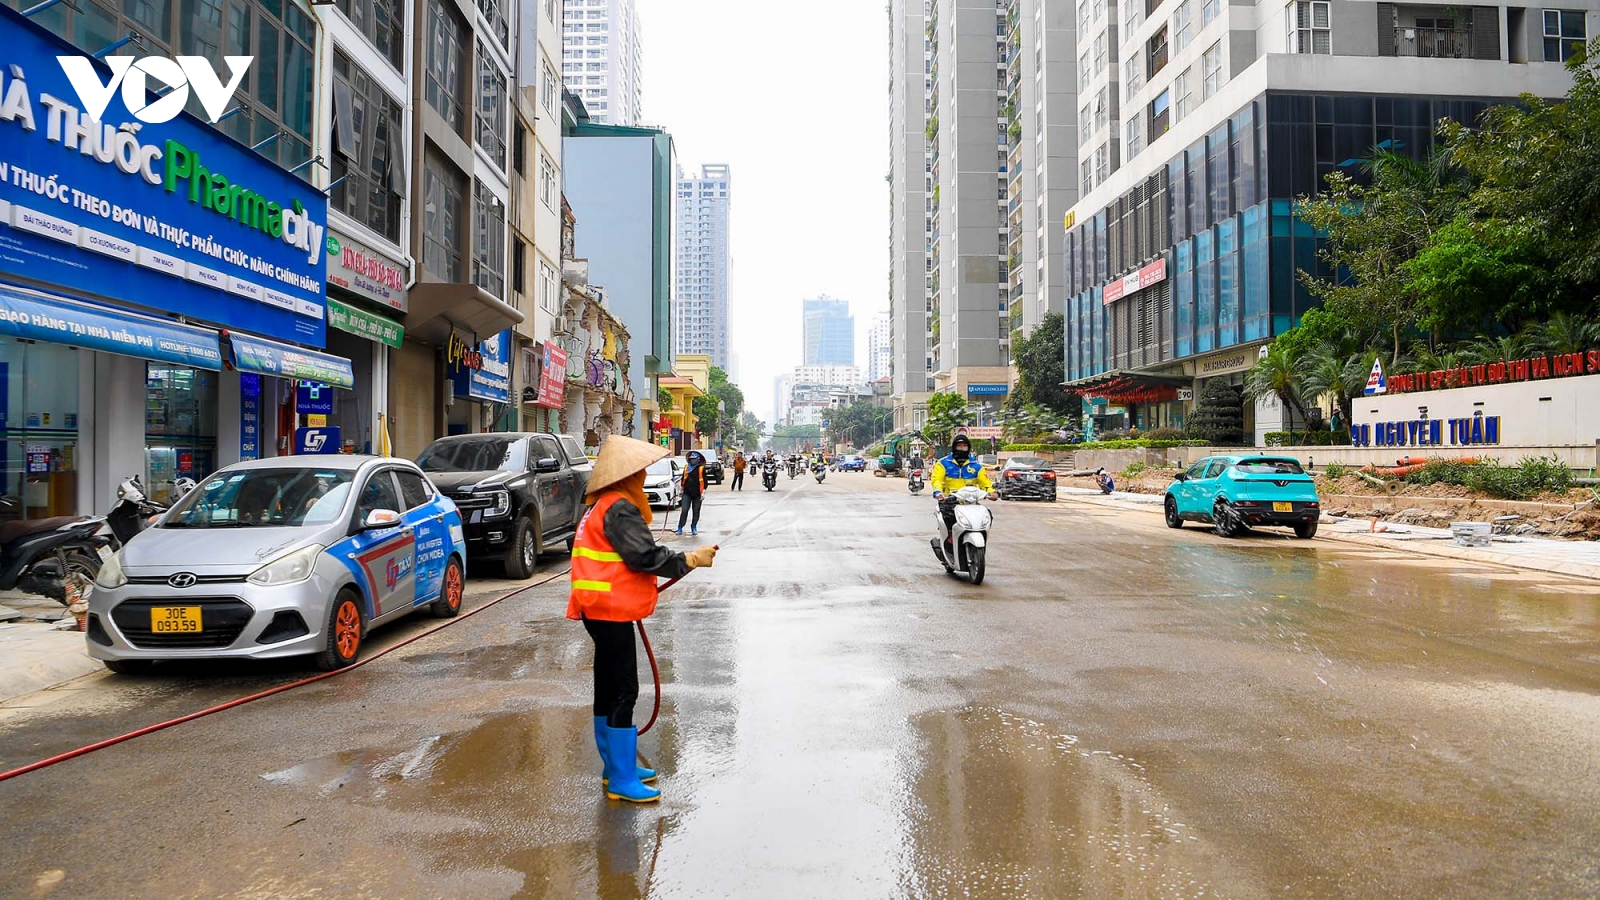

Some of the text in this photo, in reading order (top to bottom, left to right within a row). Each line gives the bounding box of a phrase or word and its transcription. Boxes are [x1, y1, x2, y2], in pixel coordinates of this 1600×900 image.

[40, 92, 163, 184] THUỐC
[164, 139, 323, 265] Pharmacity
[11, 166, 69, 204] THUỐC
[72, 188, 110, 218] THEO
[112, 204, 141, 229] ĐƠN
[144, 215, 159, 237] VÀ
[159, 221, 190, 249] THỰC
[191, 234, 222, 260] PHẨM
[223, 247, 249, 269] CHỨC
[250, 256, 274, 278] NĂNG
[275, 265, 299, 287] CHÍNH
[299, 274, 320, 294] HÀNG
[0, 309, 153, 347] GIAO HÀNG TẠI NHÀ MIỄN PHÍ
[160, 341, 189, 353] HOTLINE:
[1388, 371, 1414, 393] CÔNG
[1416, 372, 1427, 390] TY
[1429, 370, 1444, 389] CP
[1471, 363, 1487, 385] TƯ
[1488, 358, 1506, 383] ĐÔ
[1509, 358, 1529, 382] THỊ
[1531, 352, 1549, 378] VÀ
[1553, 352, 1583, 376] KCN
[1375, 409, 1443, 447] NGUYỄN
[1448, 410, 1501, 446] TUÂN
[157, 620, 197, 632] 093.59
[166, 608, 186, 619] 30E
